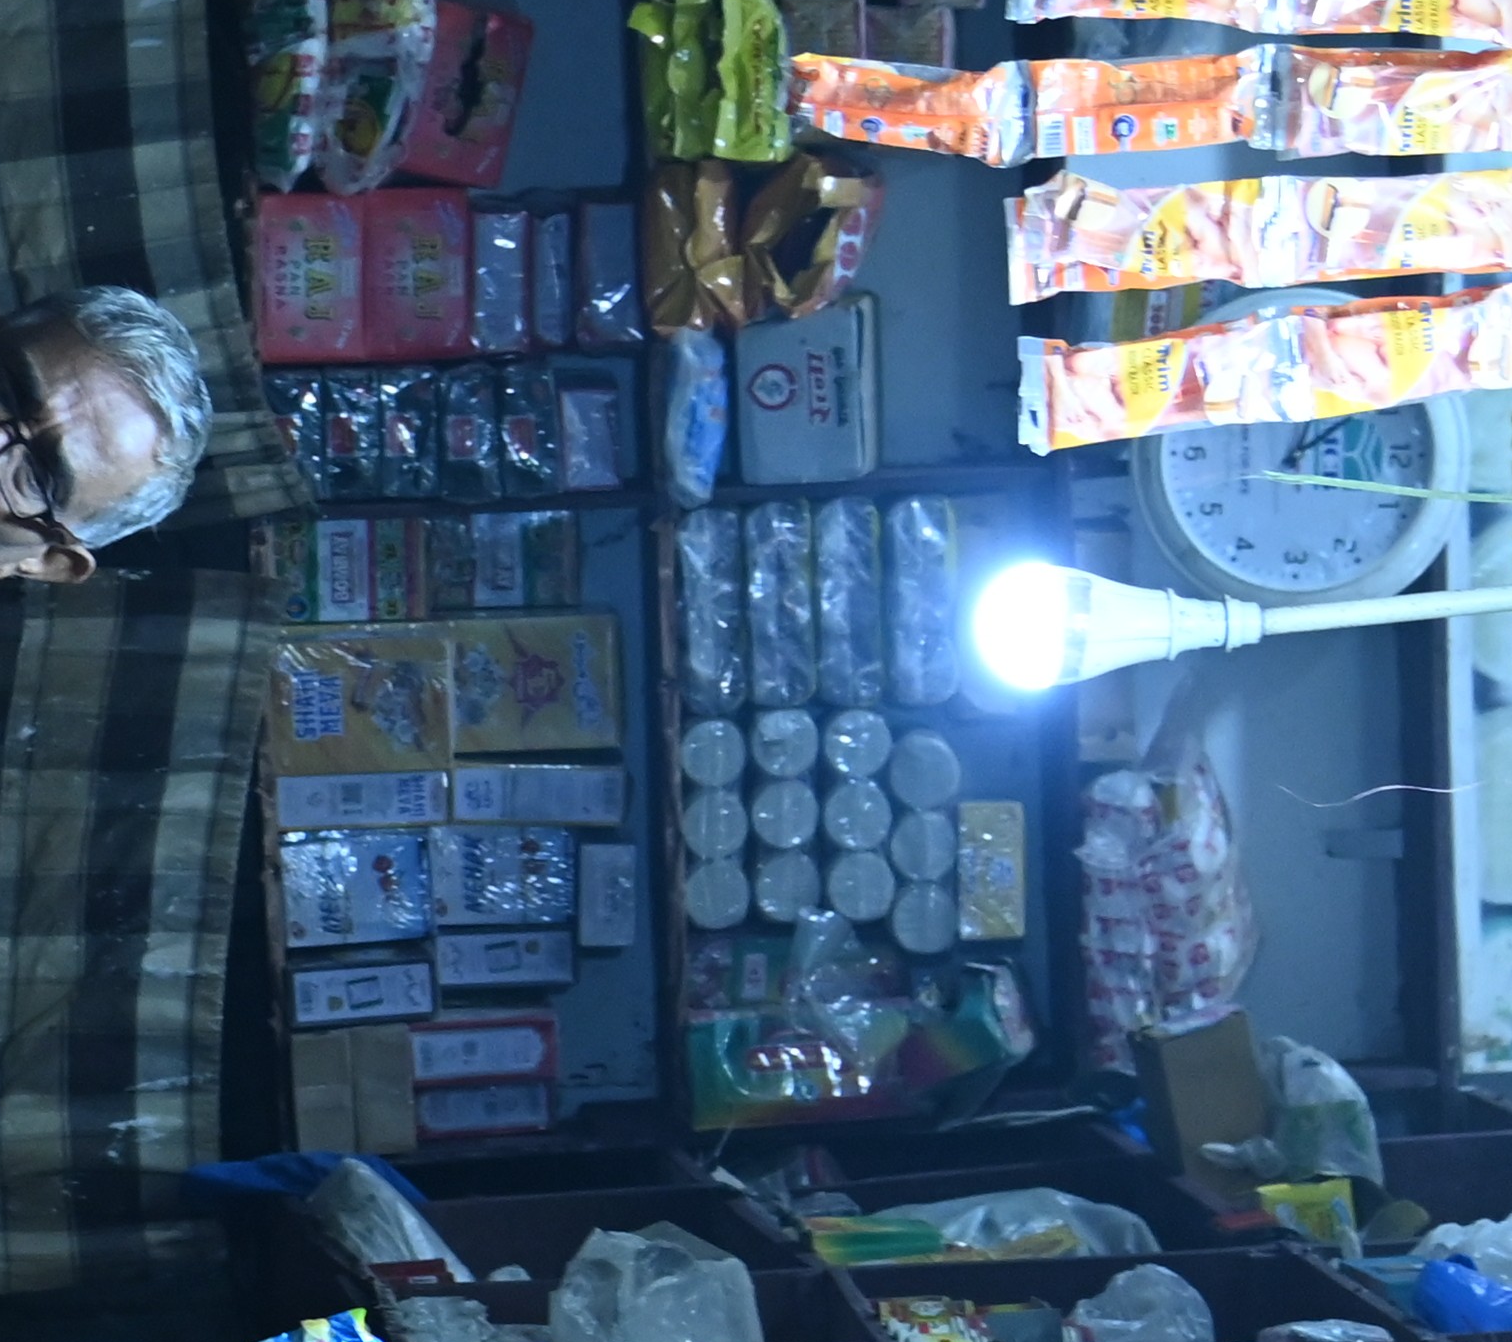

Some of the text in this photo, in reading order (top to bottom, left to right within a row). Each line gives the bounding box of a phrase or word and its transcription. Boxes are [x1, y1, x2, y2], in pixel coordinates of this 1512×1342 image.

[289, 259, 303, 297] PAN
[303, 235, 337, 322] RAJ
[412, 234, 447, 320] RAJ
[1155, 344, 1172, 393] Trim
[1388, 443, 1412, 469] 12
[292, 671, 320, 740] SHAHI
[319, 676, 343, 735] MEVA
